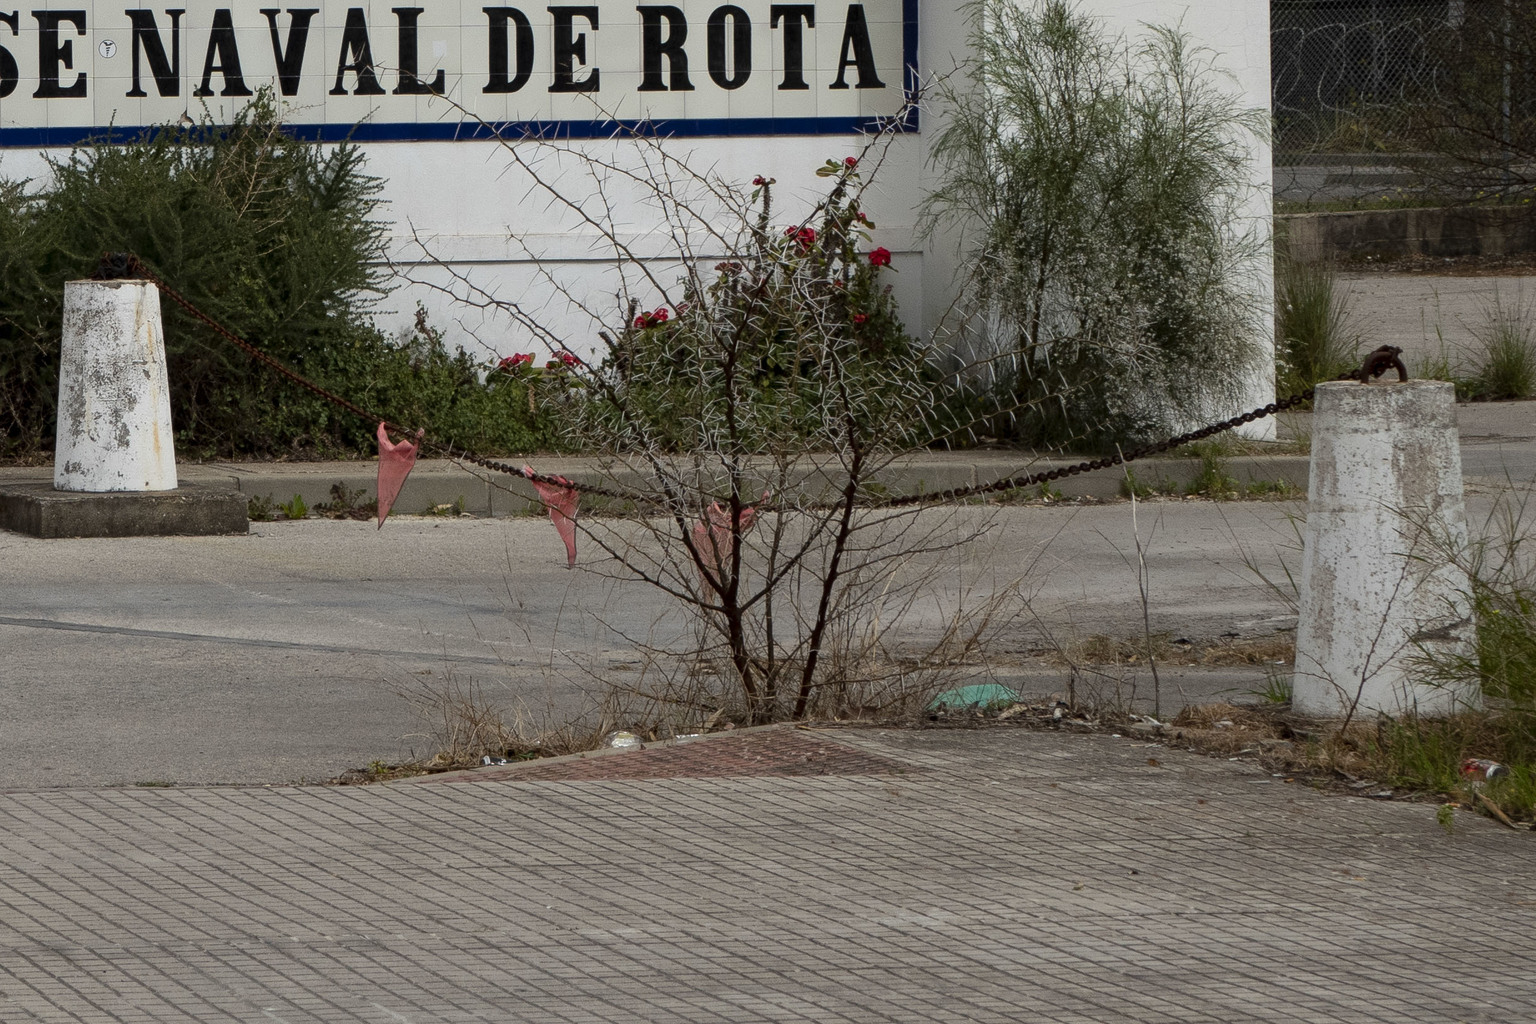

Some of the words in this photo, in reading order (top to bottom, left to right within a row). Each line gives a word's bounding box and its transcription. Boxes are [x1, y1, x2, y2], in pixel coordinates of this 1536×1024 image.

[124, 6, 446, 98] NAVAL
[482, 5, 600, 94] DE
[636, 3, 887, 92] ROTA
